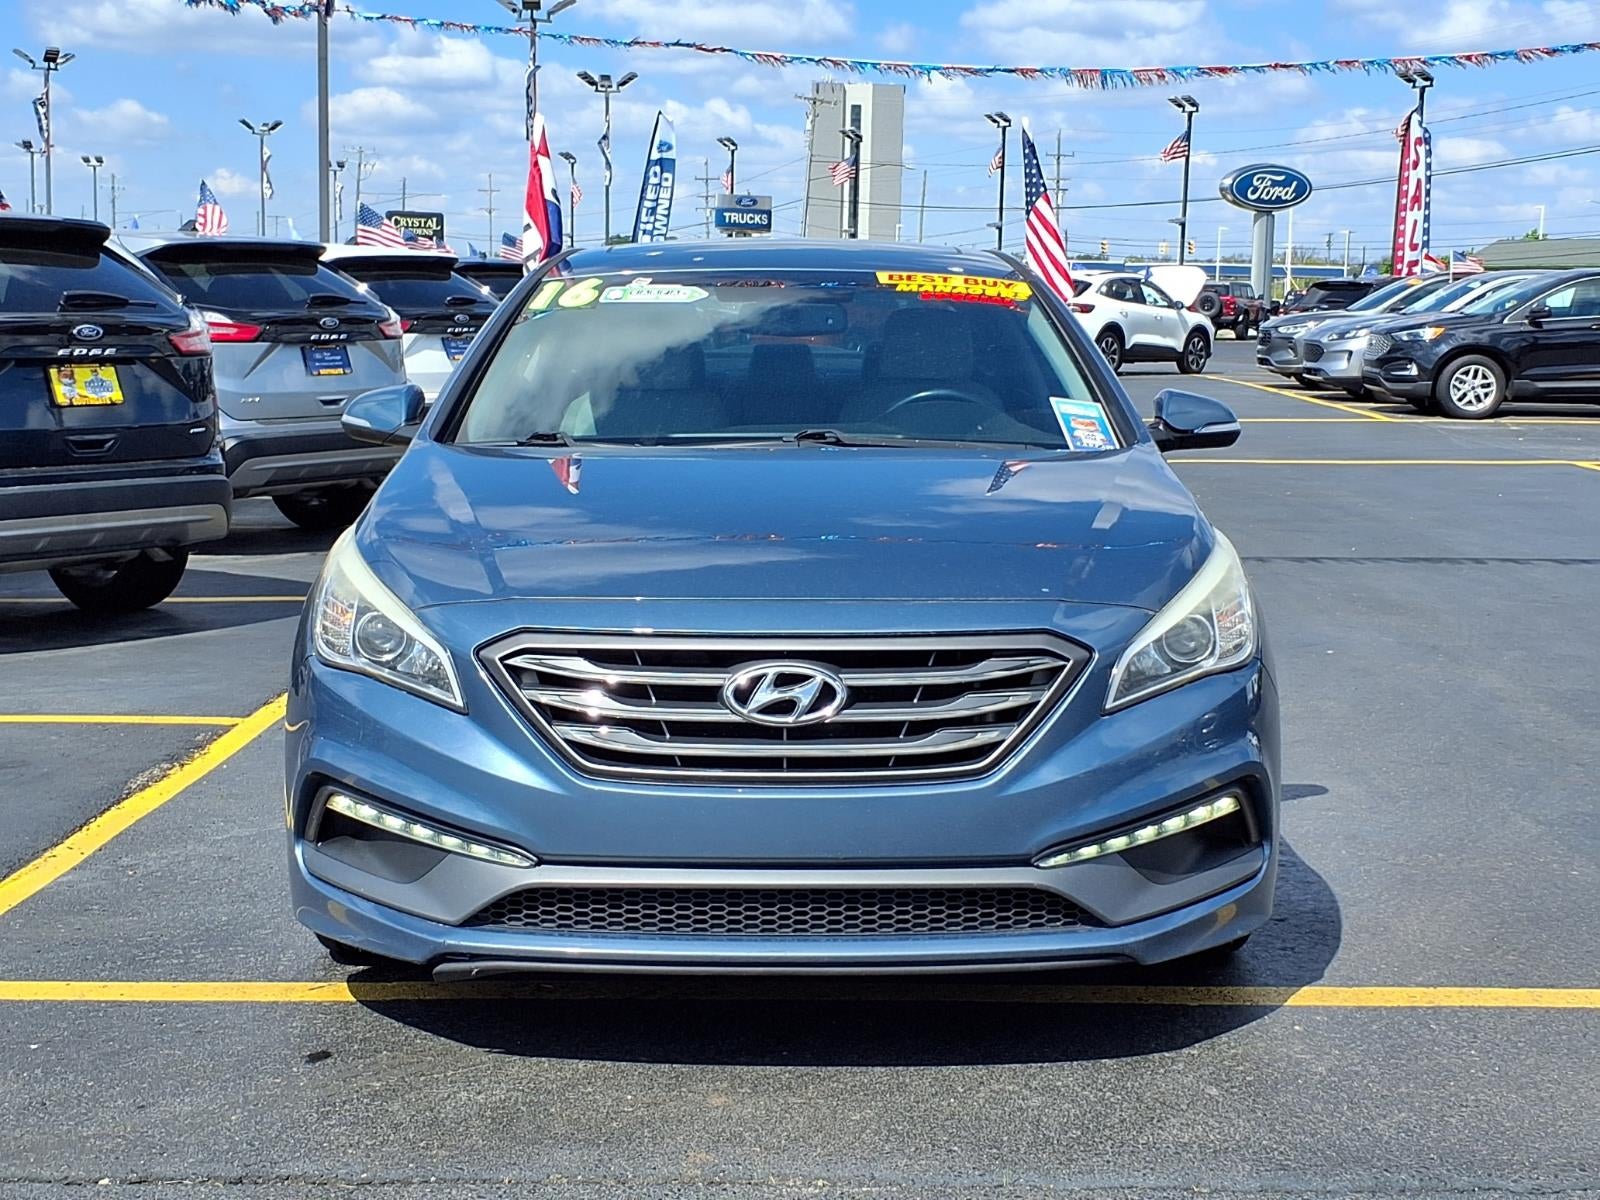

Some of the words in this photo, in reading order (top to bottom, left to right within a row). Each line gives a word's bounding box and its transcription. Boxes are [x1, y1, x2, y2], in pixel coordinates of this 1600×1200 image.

[1247, 173, 1298, 200] Ford
[1405, 136, 1424, 276] SALE
[391, 215, 442, 231] CRYSTAL
[723, 212, 769, 225] TRUCKS
[888, 273, 953, 284] BEST
[963, 277, 1016, 289] BUY
[528, 278, 594, 310] 16
[57, 348, 117, 356] EDGE
